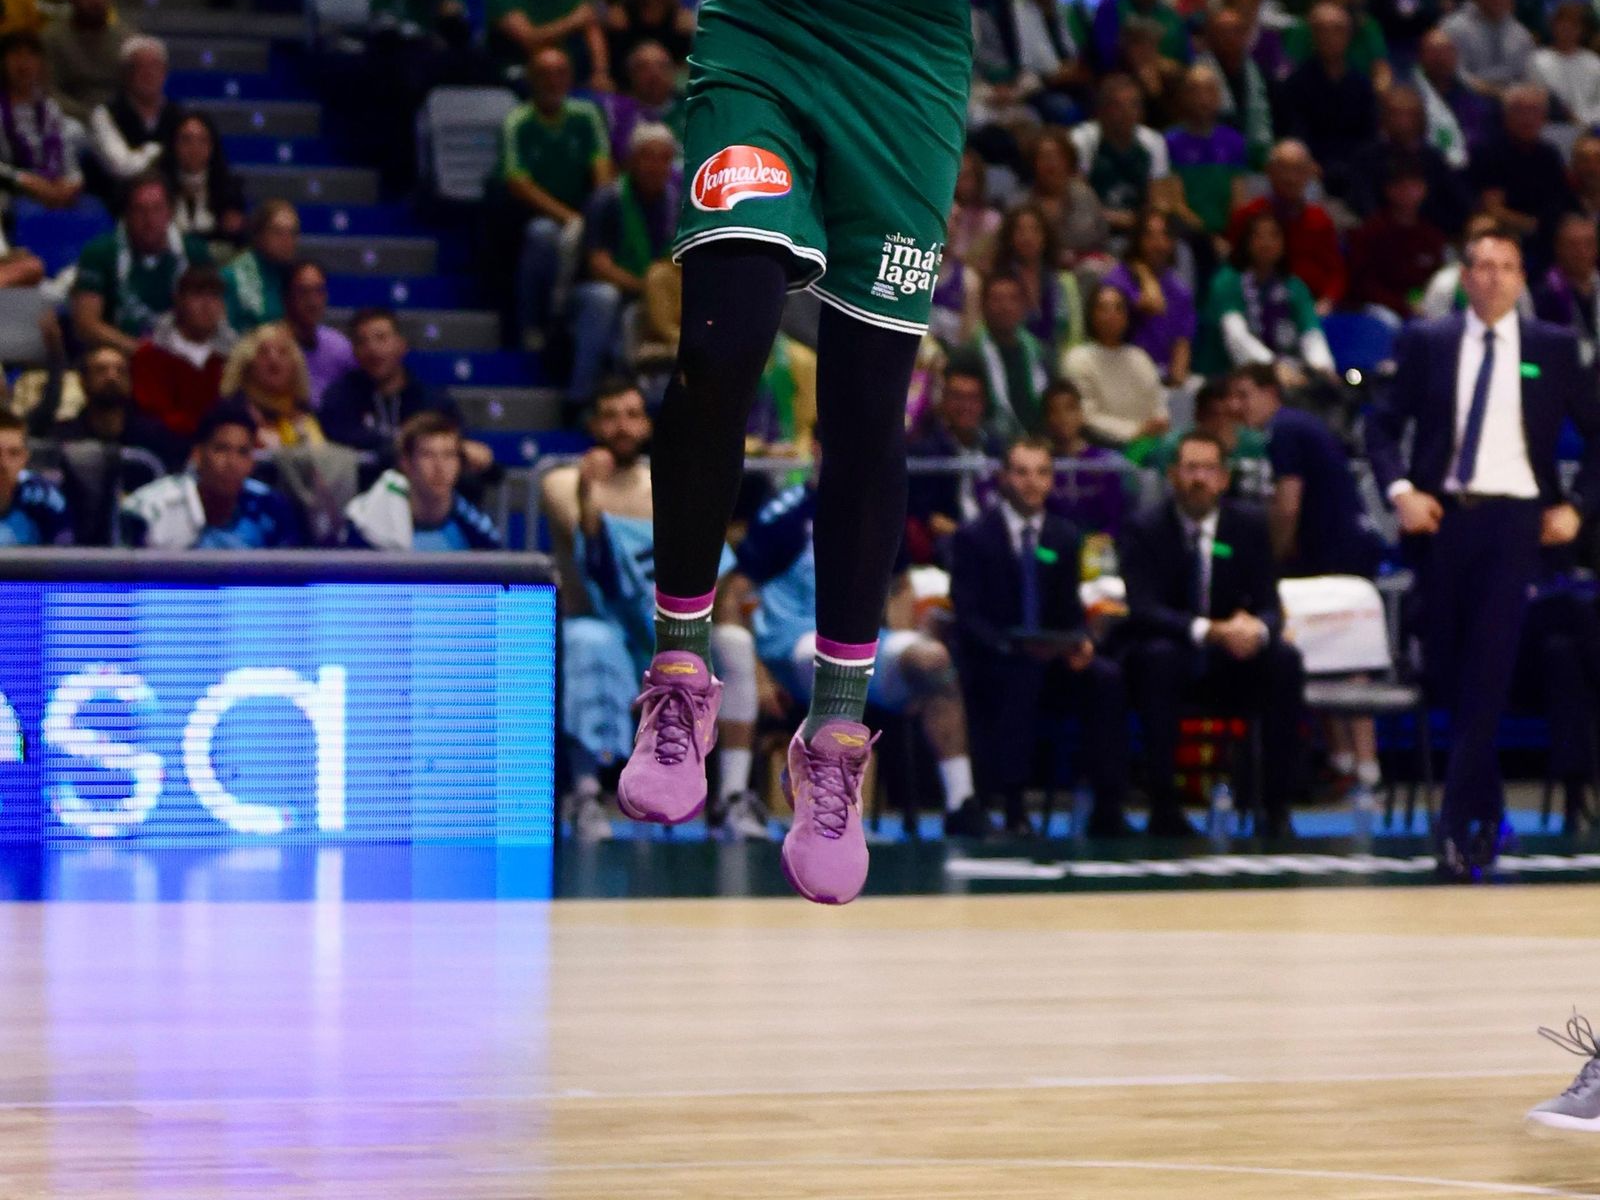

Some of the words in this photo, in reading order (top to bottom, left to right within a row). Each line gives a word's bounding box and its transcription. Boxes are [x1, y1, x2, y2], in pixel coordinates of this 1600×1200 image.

[699, 152, 788, 203] famadesa
[886, 232, 916, 246] sabor
[882, 241, 892, 253] a
